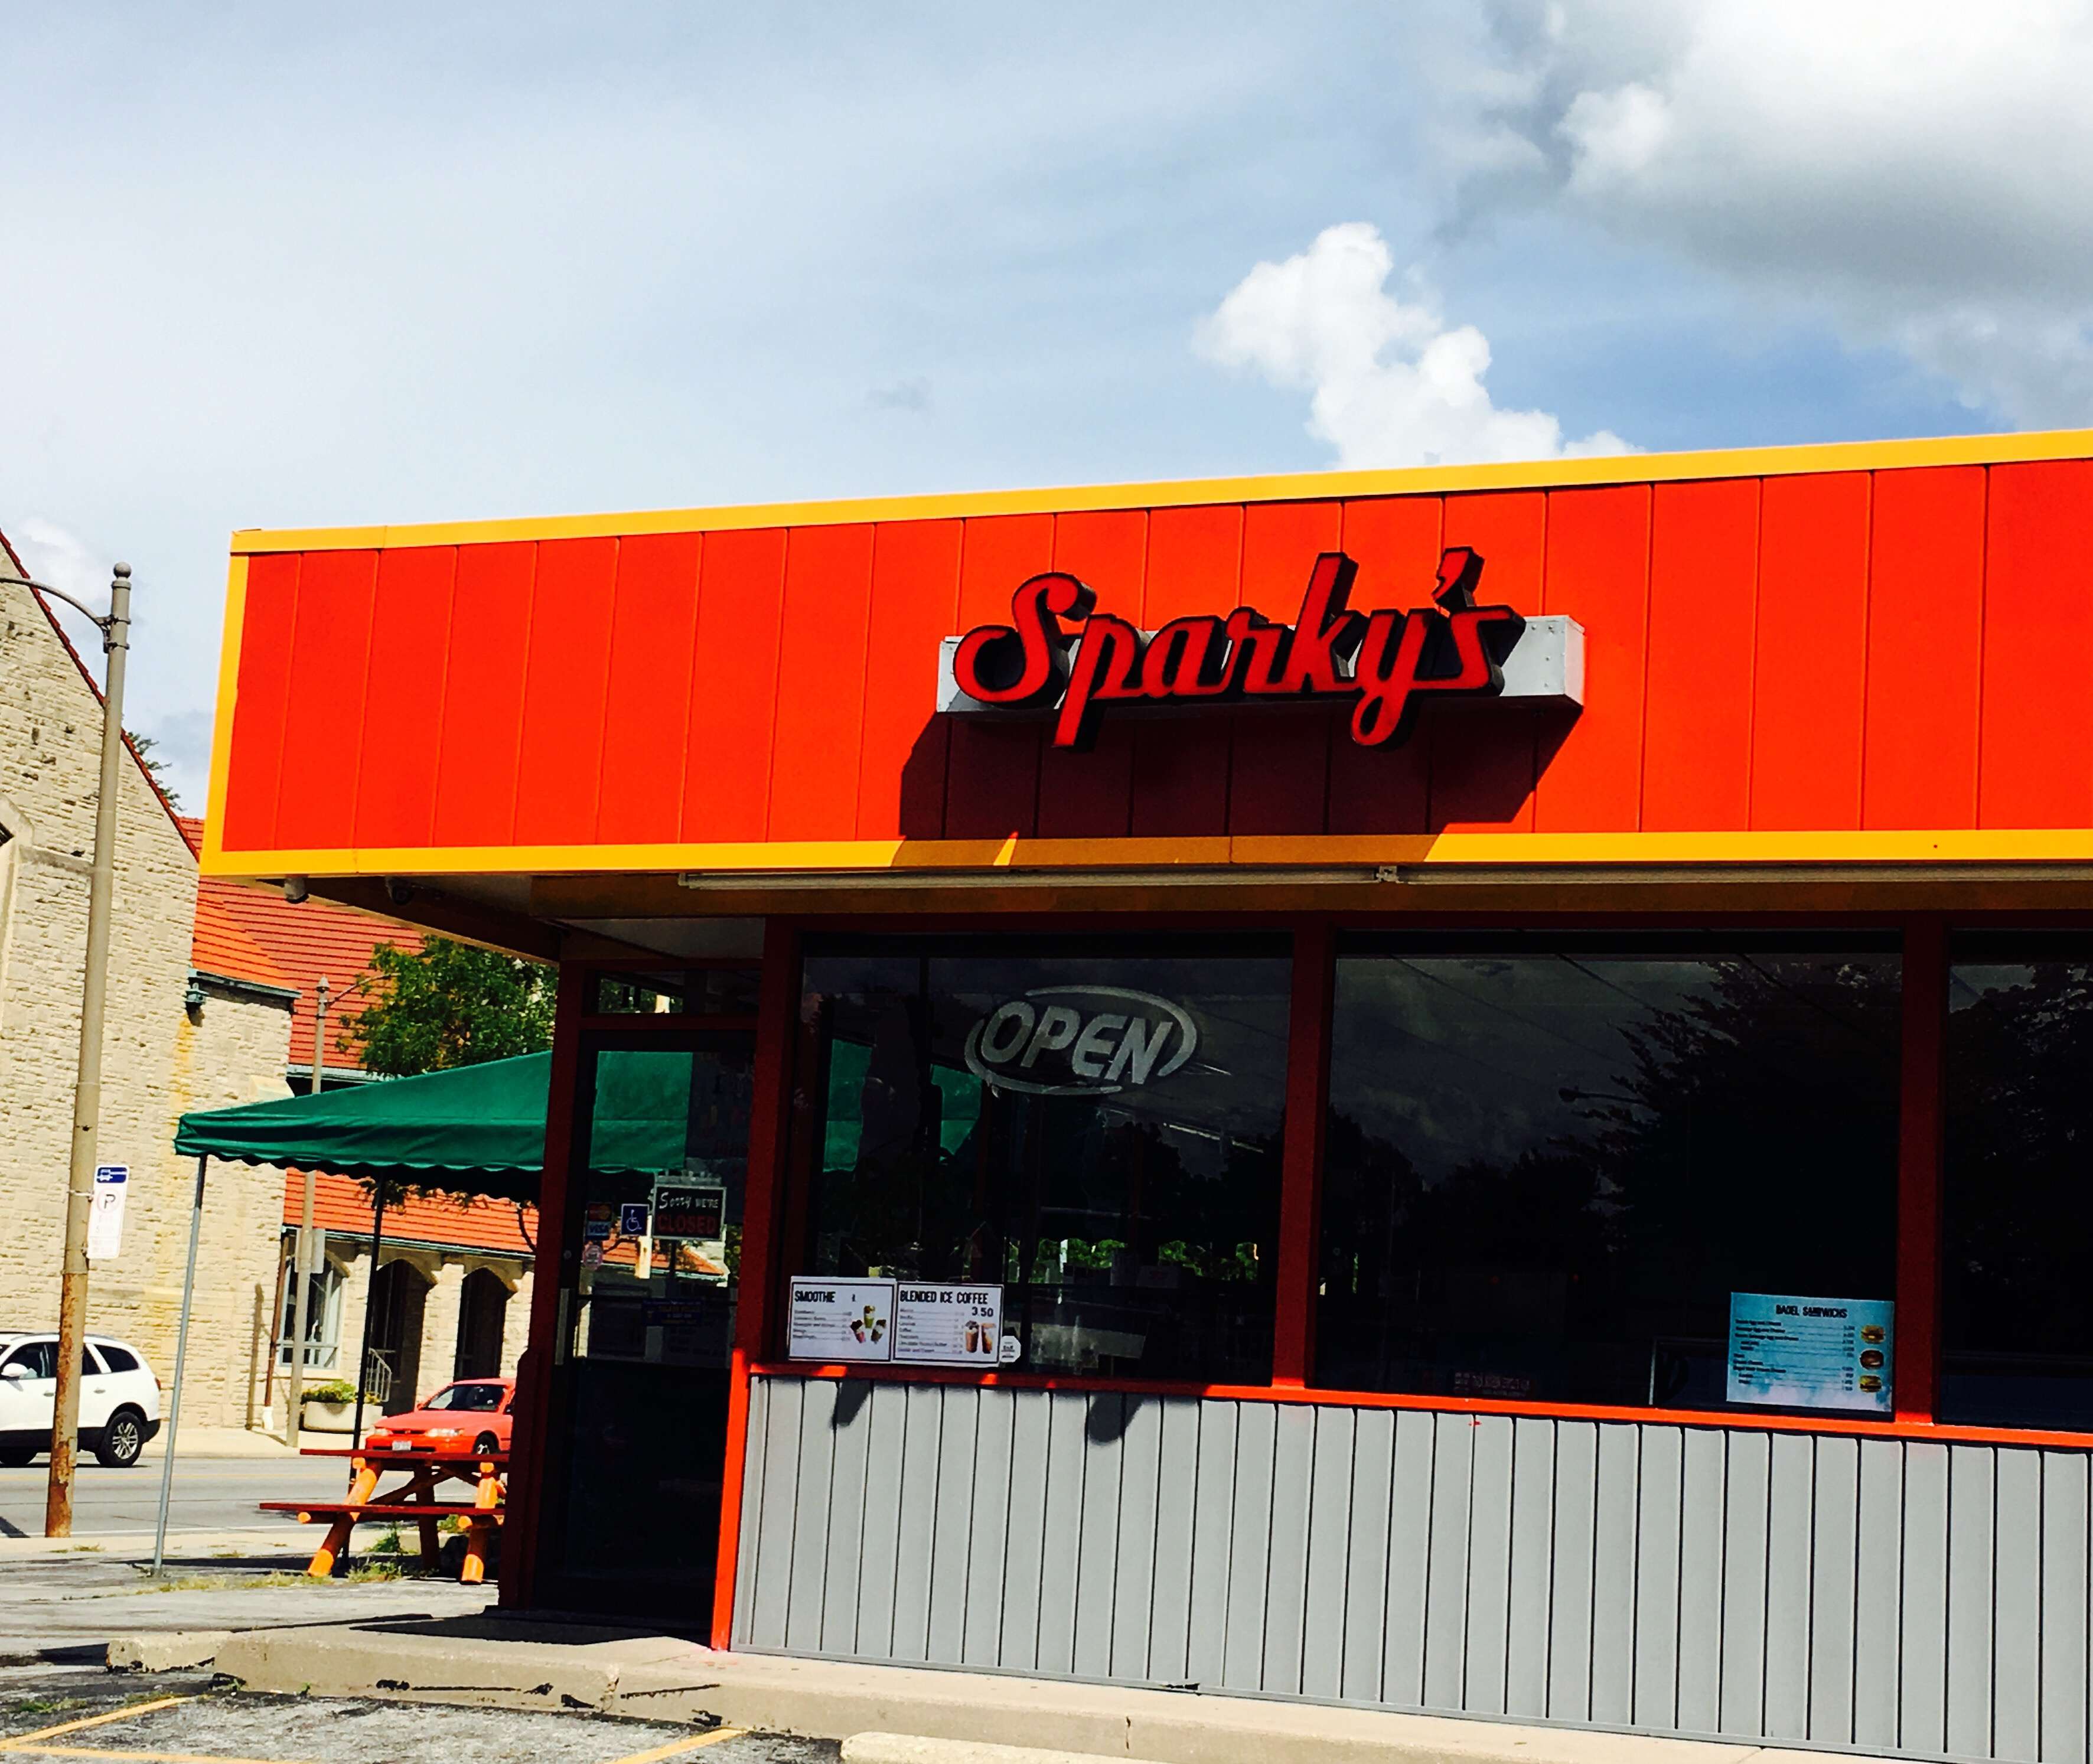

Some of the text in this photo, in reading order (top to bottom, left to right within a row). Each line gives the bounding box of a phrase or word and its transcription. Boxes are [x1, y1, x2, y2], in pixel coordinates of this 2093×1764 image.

[952, 546, 1523, 748] Sparky's
[981, 1001, 1173, 1084] OPEN
[103, 1194, 116, 1209] P
[657, 1213, 716, 1234] CLOSED
[794, 1290, 836, 1303] SMOOTHIE
[899, 1290, 989, 1305] BLENDED ICE COFFEE
[1775, 1305, 1799, 1316] BAGEL
